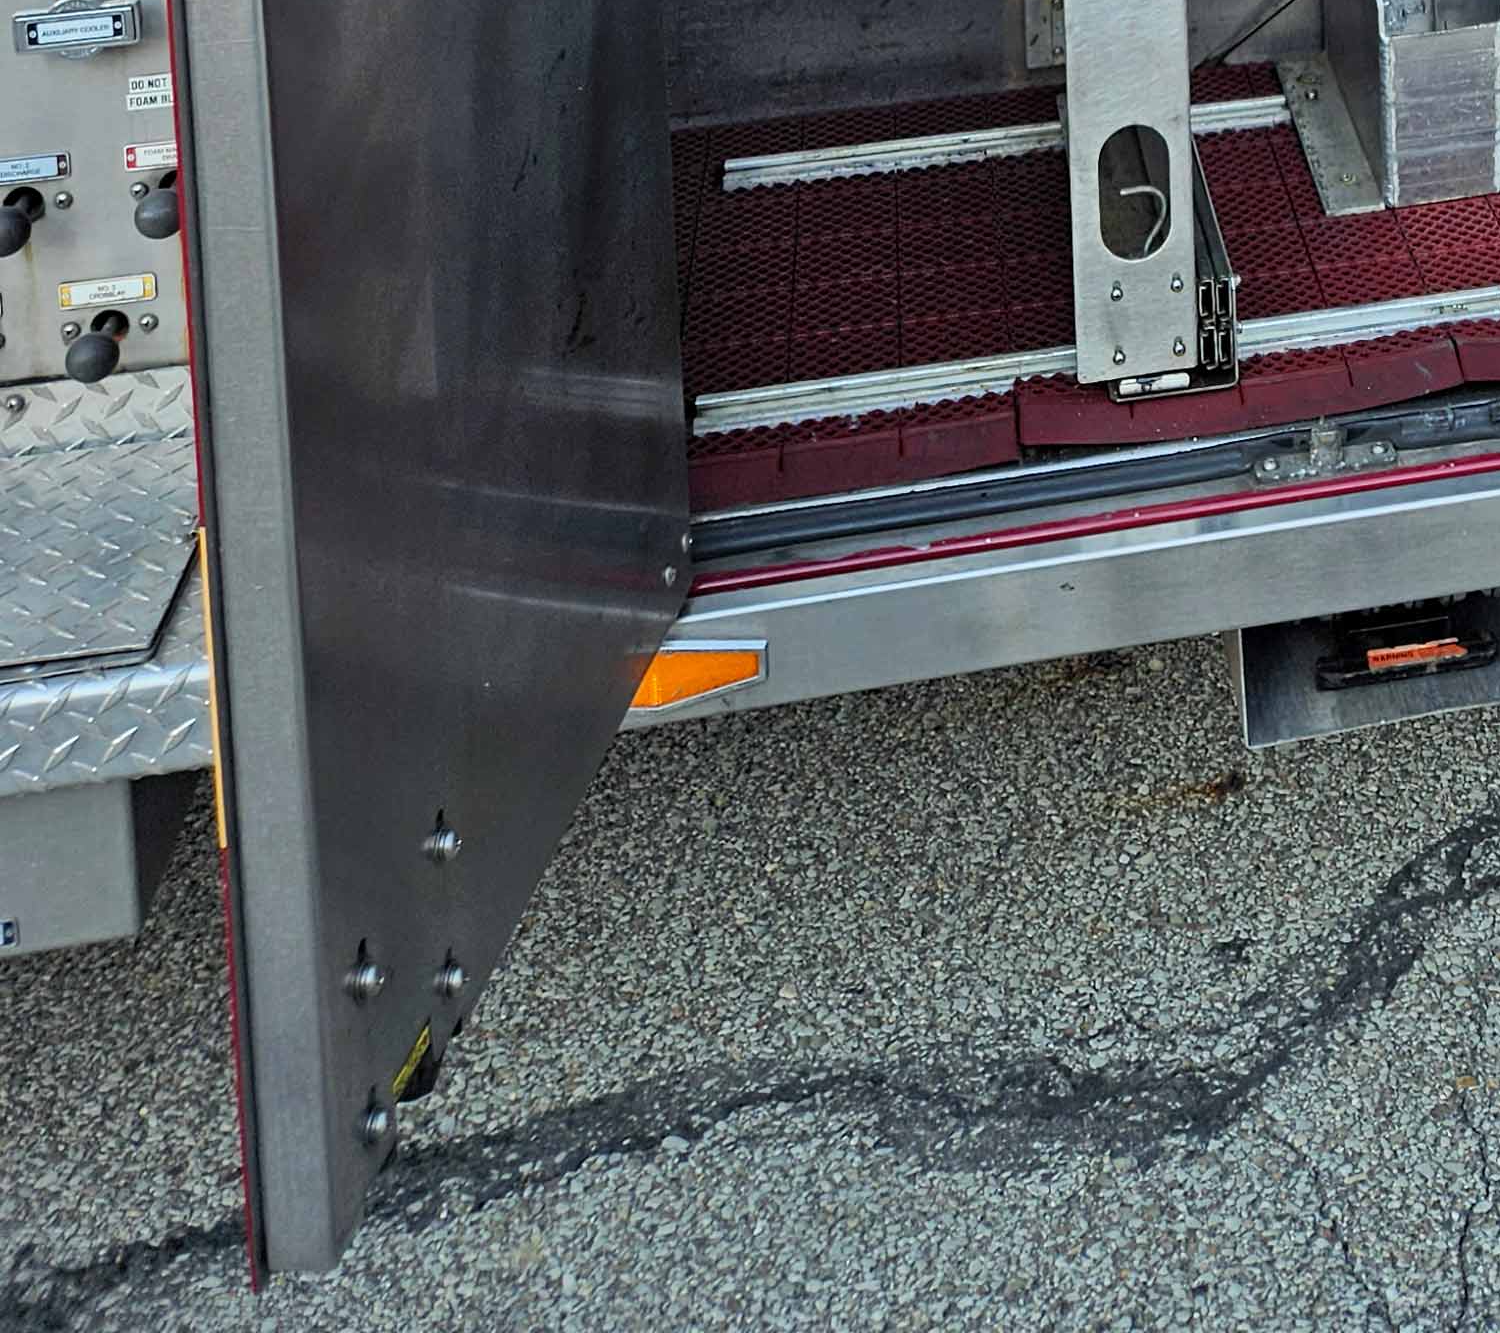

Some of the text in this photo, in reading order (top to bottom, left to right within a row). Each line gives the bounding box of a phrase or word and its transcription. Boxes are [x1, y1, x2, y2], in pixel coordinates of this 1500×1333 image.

[131, 77, 168, 91] DO NOT
[129, 95, 158, 108] FOAM
